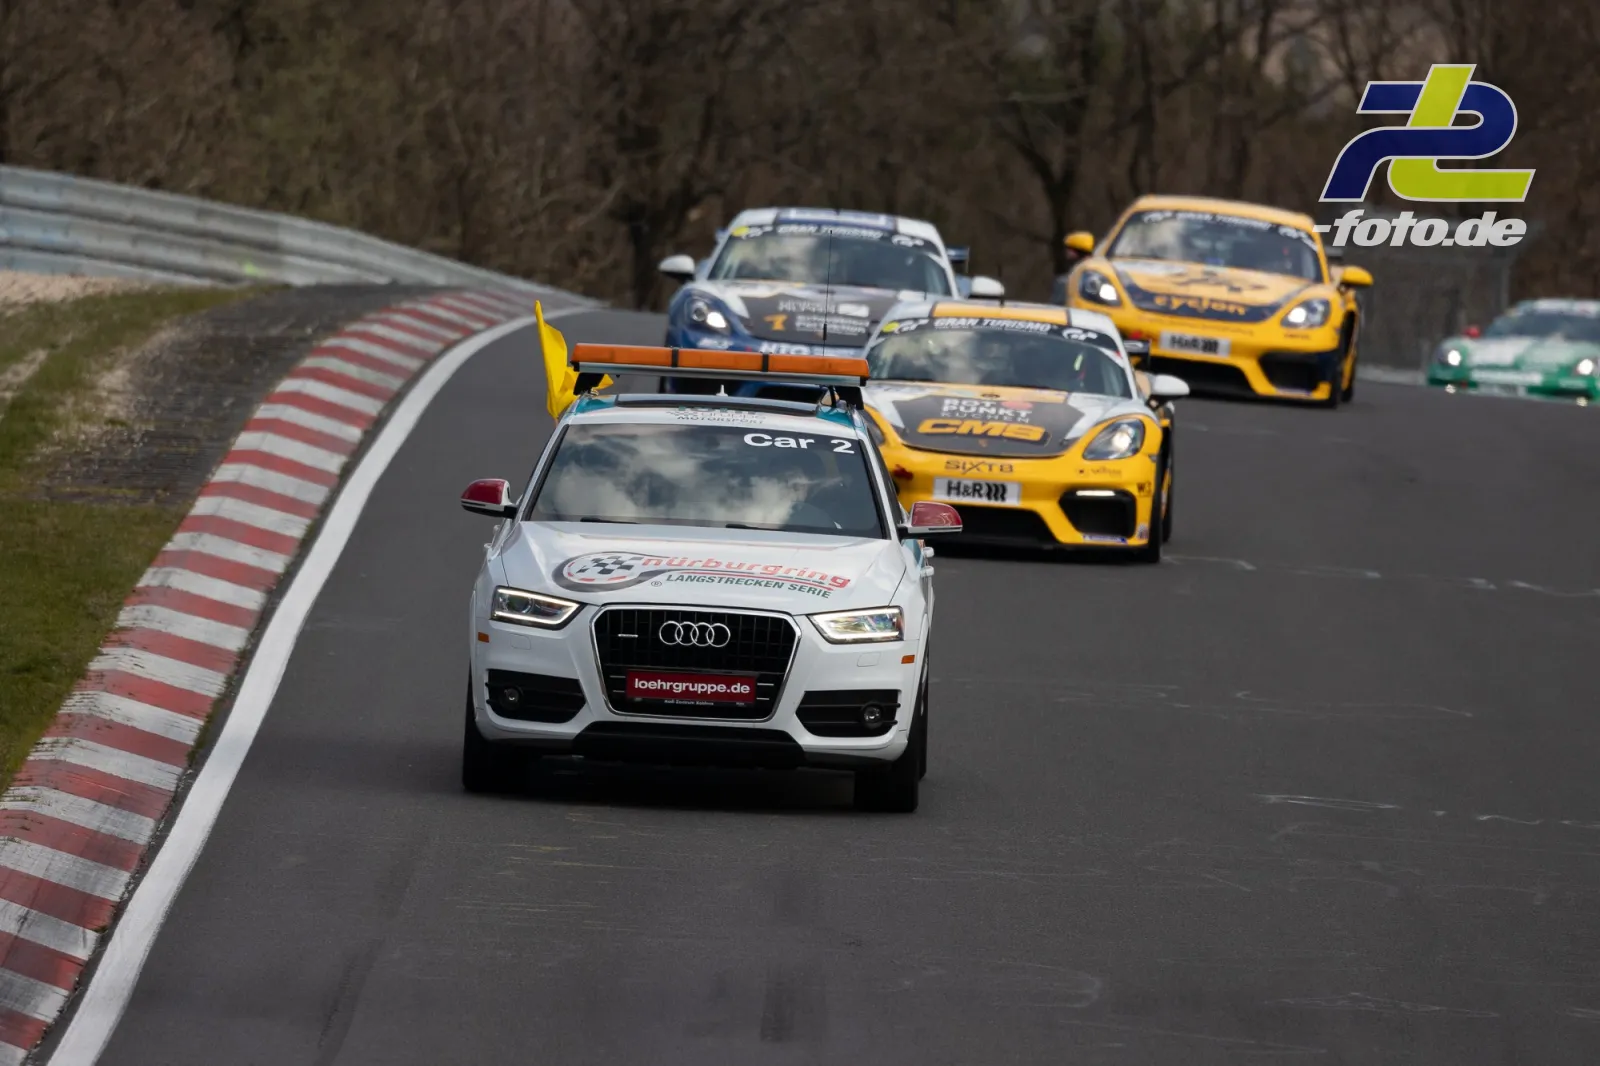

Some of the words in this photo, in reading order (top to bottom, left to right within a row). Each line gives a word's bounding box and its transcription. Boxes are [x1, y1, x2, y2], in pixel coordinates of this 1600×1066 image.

[934, 317, 980, 327] GRAN
[982, 318, 1051, 332] TURISMO
[943, 398, 997, 408] ROT
[941, 412, 1030, 424] KUCHEN
[943, 405, 1033, 418] PUNKT
[677, 415, 764, 425] MOTORSPORT
[917, 418, 1046, 442] CMS
[743, 432, 815, 449] Car
[830, 439, 855, 454] 2
[946, 480, 984, 498] H&R
[641, 556, 851, 589] nürburgring
[665, 574, 785, 589] LANGSTRECKEN
[788, 582, 832, 599] SERIE
[634, 678, 750, 694] loehrgruppe.de
